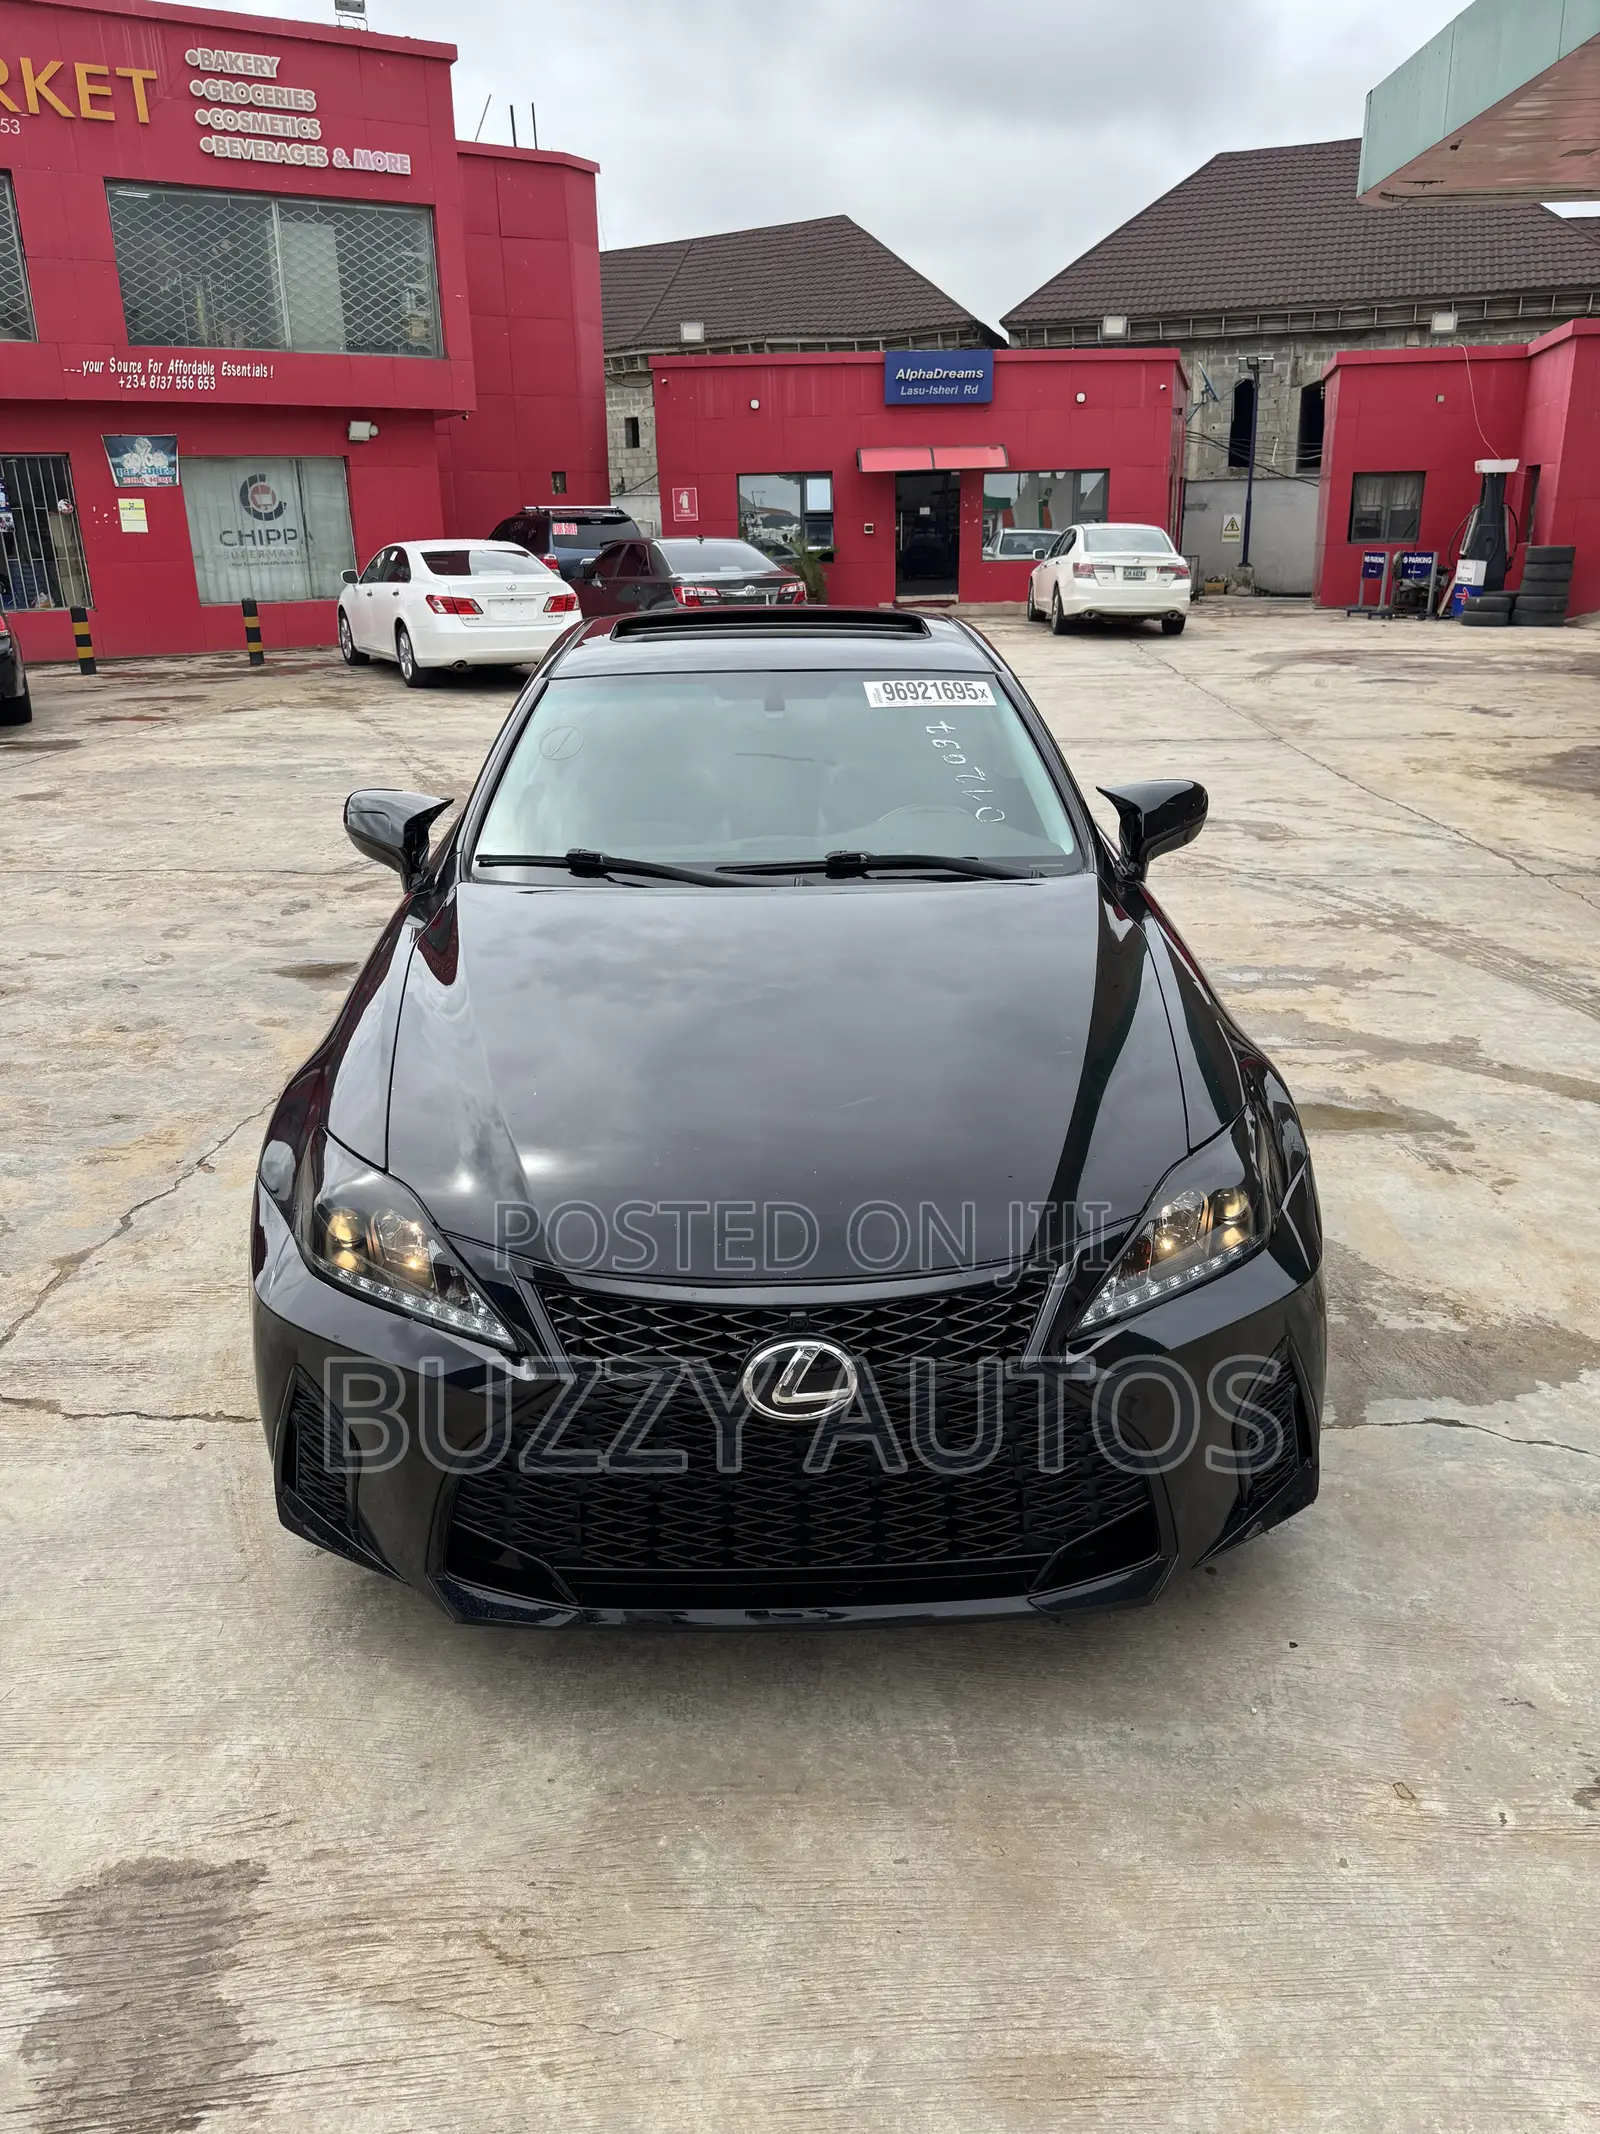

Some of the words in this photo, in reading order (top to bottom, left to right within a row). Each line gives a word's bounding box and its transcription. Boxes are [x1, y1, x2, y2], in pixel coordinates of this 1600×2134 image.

[198, 48, 281, 78] BAKERY
[203, 78, 316, 112] GROCERIES
[209, 108, 321, 140] COSMETICS
[212, 135, 329, 168] BEVERAGES
[332, 148, 351, 169] &
[353, 149, 411, 175] MORE
[109, 357, 142, 373] Source
[148, 359, 163, 374] For
[168, 359, 215, 376] Affordable
[895, 368, 984, 382] AlphaDreams
[118, 375, 146, 389] +234
[149, 376, 171, 389] 8137
[175, 376, 194, 389] 556
[197, 376, 216, 390] 653
[963, 385, 979, 395] Rd
[1408, 556, 1433, 564] PARKING
